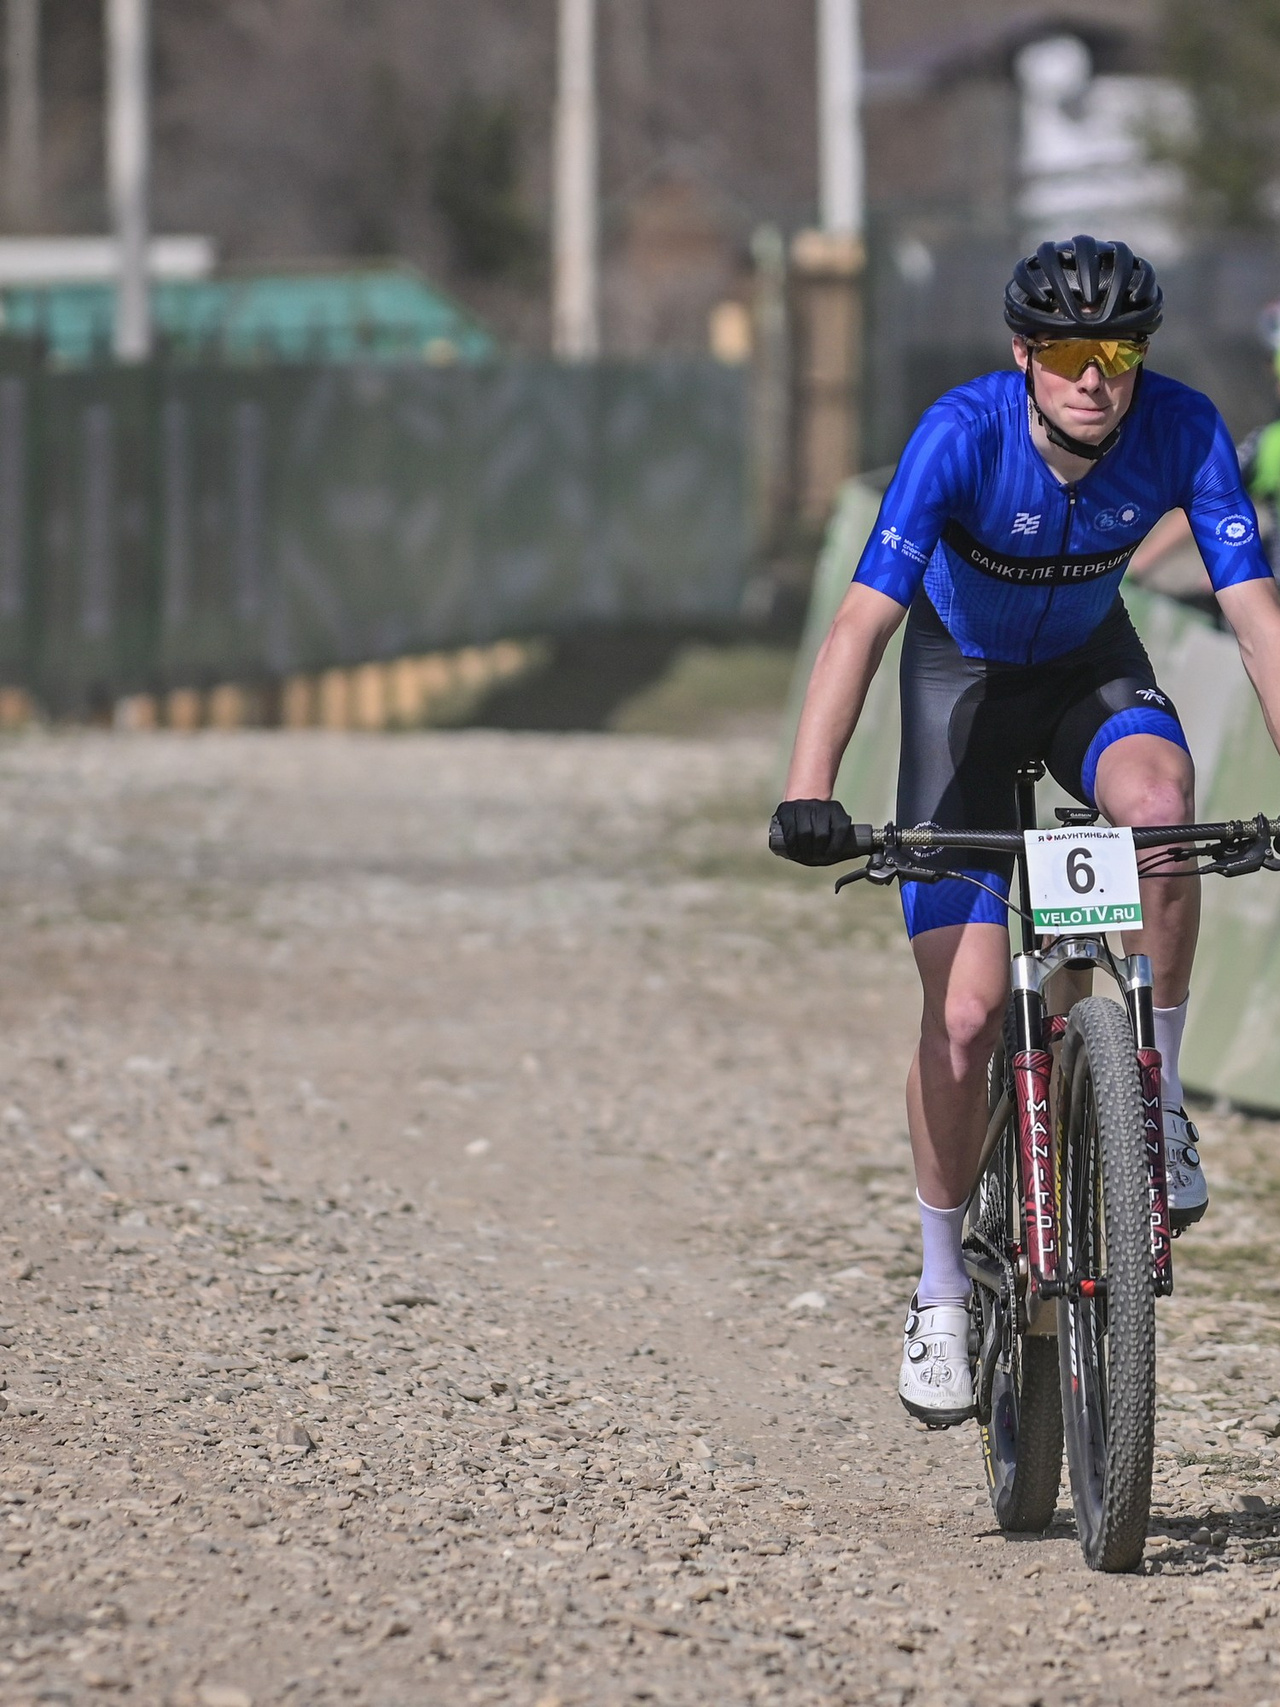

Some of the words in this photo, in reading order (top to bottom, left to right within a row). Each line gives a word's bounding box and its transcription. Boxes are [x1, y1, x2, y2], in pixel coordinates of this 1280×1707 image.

[1054, 832, 1120, 842] МАУНТИНБАЙК
[1027, 1099, 1054, 1252] MANITOU
[1142, 1097, 1163, 1250] MANITOU
